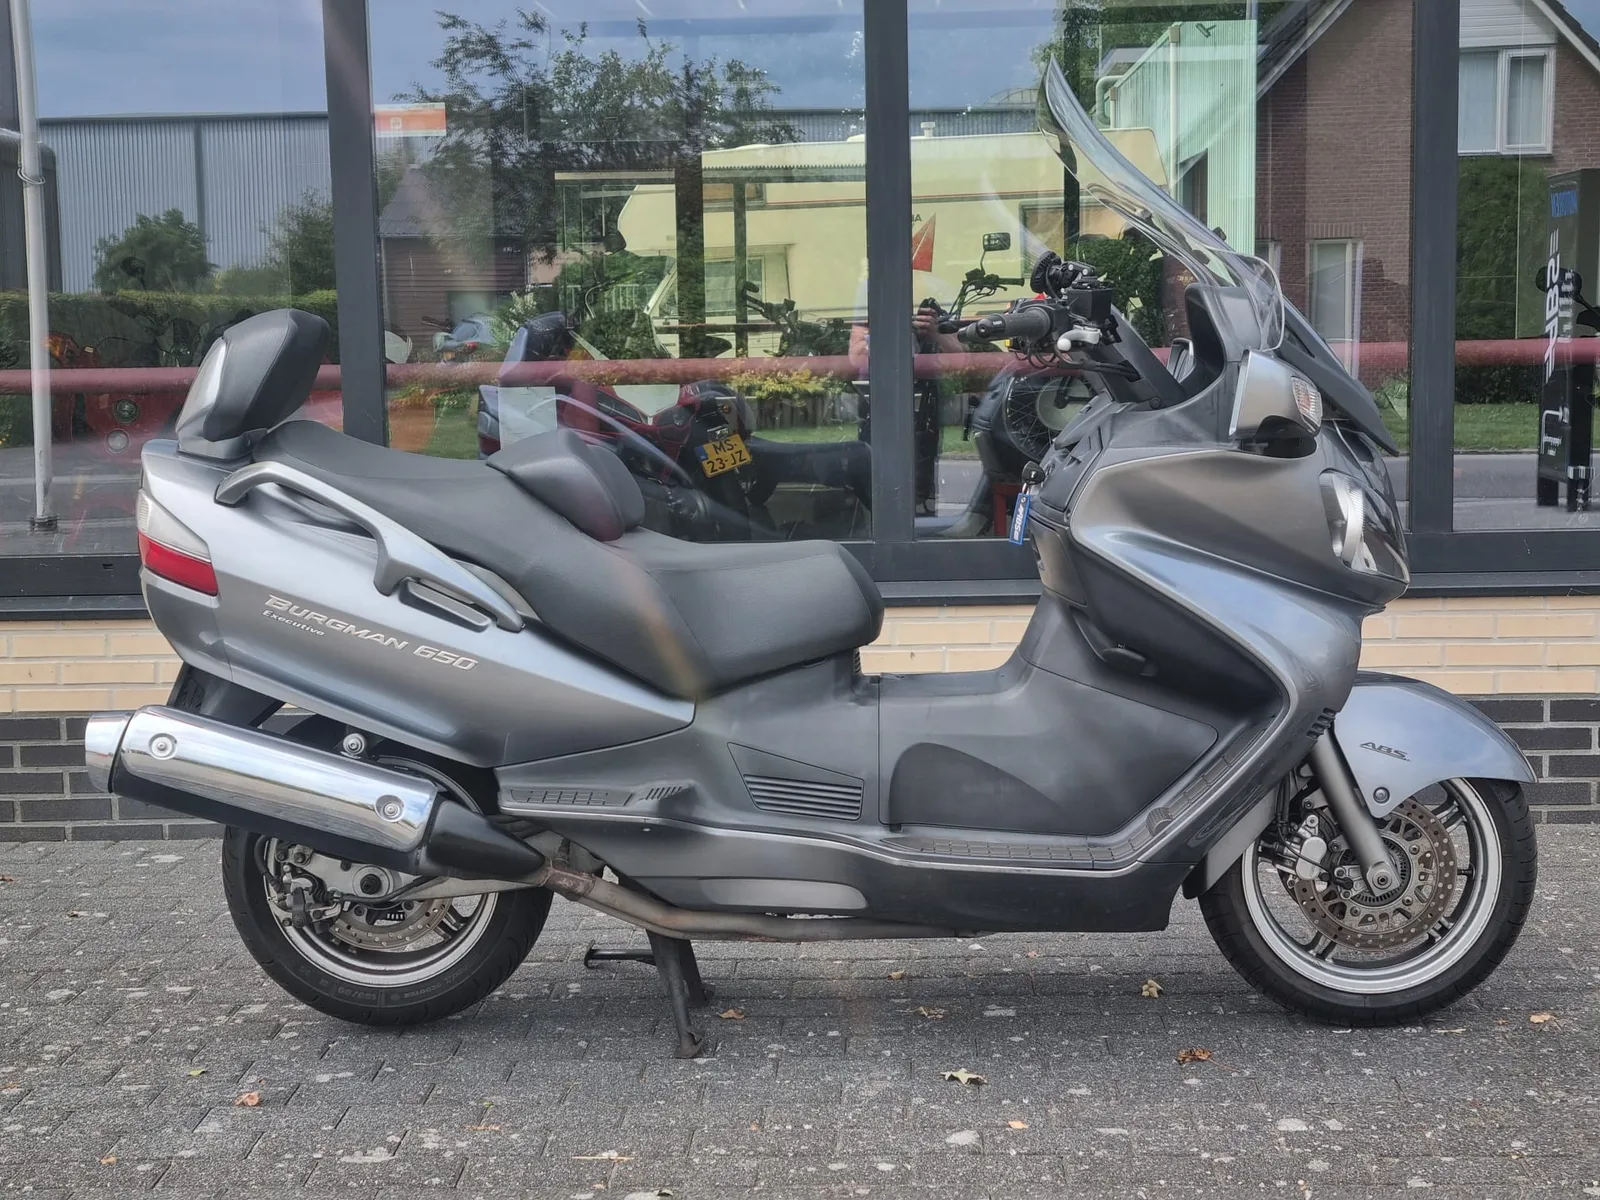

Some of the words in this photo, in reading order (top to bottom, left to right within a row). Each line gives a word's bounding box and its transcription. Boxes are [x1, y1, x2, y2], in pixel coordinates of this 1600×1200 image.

[707, 450, 746, 473] 23-JZ
[262, 609, 325, 636] Executive
[264, 595, 409, 651] BURGMAN
[413, 645, 479, 671] 650
[1359, 742, 1408, 758] ABS
